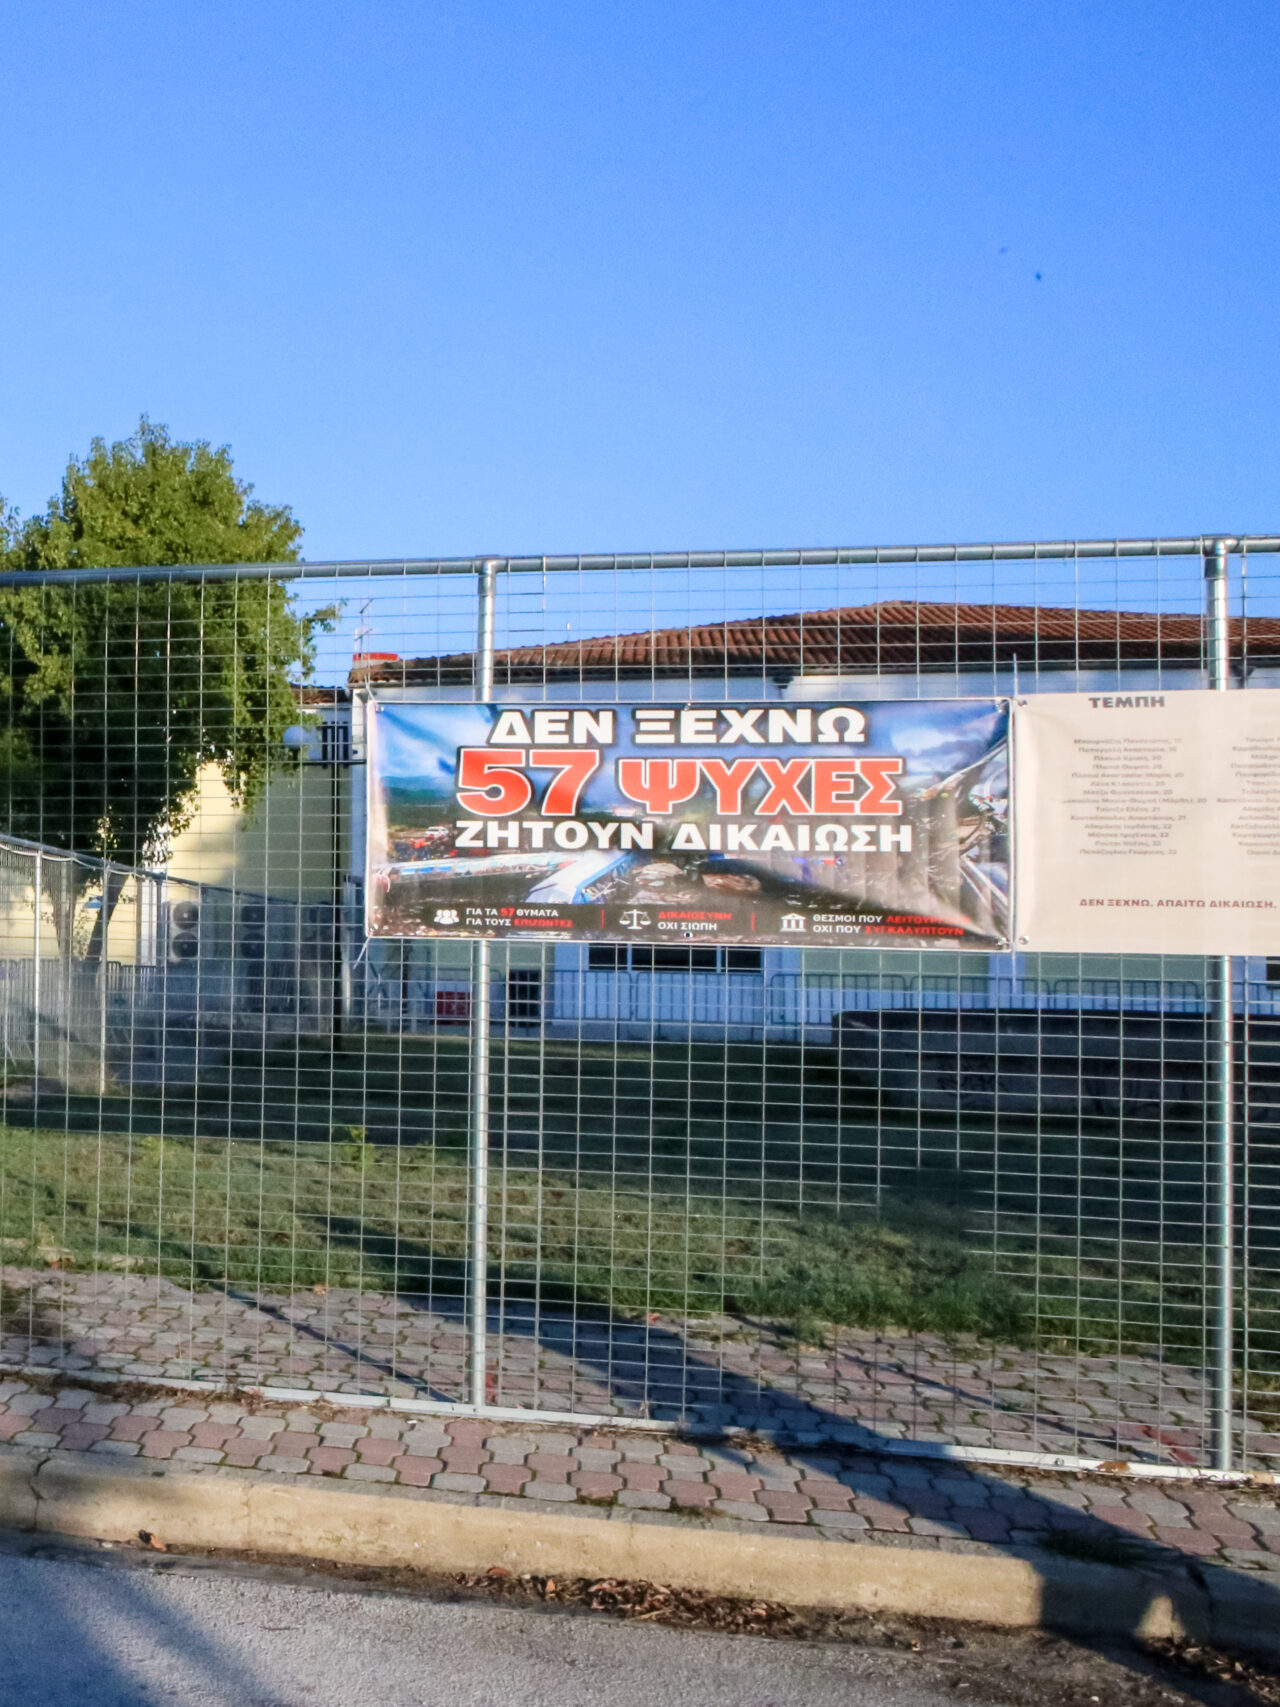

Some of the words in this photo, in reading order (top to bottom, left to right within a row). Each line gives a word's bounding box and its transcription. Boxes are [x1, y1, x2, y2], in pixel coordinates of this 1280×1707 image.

[1088, 695, 1165, 709] ΤΕΜΠΗ
[489, 710, 613, 744] ΔΕΝ
[635, 707, 865, 744] ΞΕΧΝΩ
[456, 748, 600, 817] 57
[618, 758, 903, 815] ΨΥΧΕΣ
[455, 820, 654, 850] ΖΗΤΟΥΝ
[671, 823, 913, 853] ΔΙΚΑΙΩΣΗ
[1080, 898, 1105, 907] ΔΕΝ
[1157, 898, 1206, 908] ΑΠΑΙΤΩ
[466, 907, 483, 916] ΓΙΑ
[485, 907, 498, 916] ΤΑ
[500, 907, 516, 917] 57
[516, 908, 559, 918] ΘΥΜΑΤΑ
[466, 918, 483, 926] ΓΙΑ
[485, 918, 512, 926] ΤΟΥΣ
[812, 914, 856, 923] ΘΕΣΜΟΙ
[858, 914, 883, 923] ΠΟΥ
[657, 921, 678, 930] ΟΧΙ
[680, 921, 718, 931] ΣΙΩΠΗ
[812, 924, 833, 933] ΟΧΙ
[835, 925, 861, 934] ΠΟΥ
